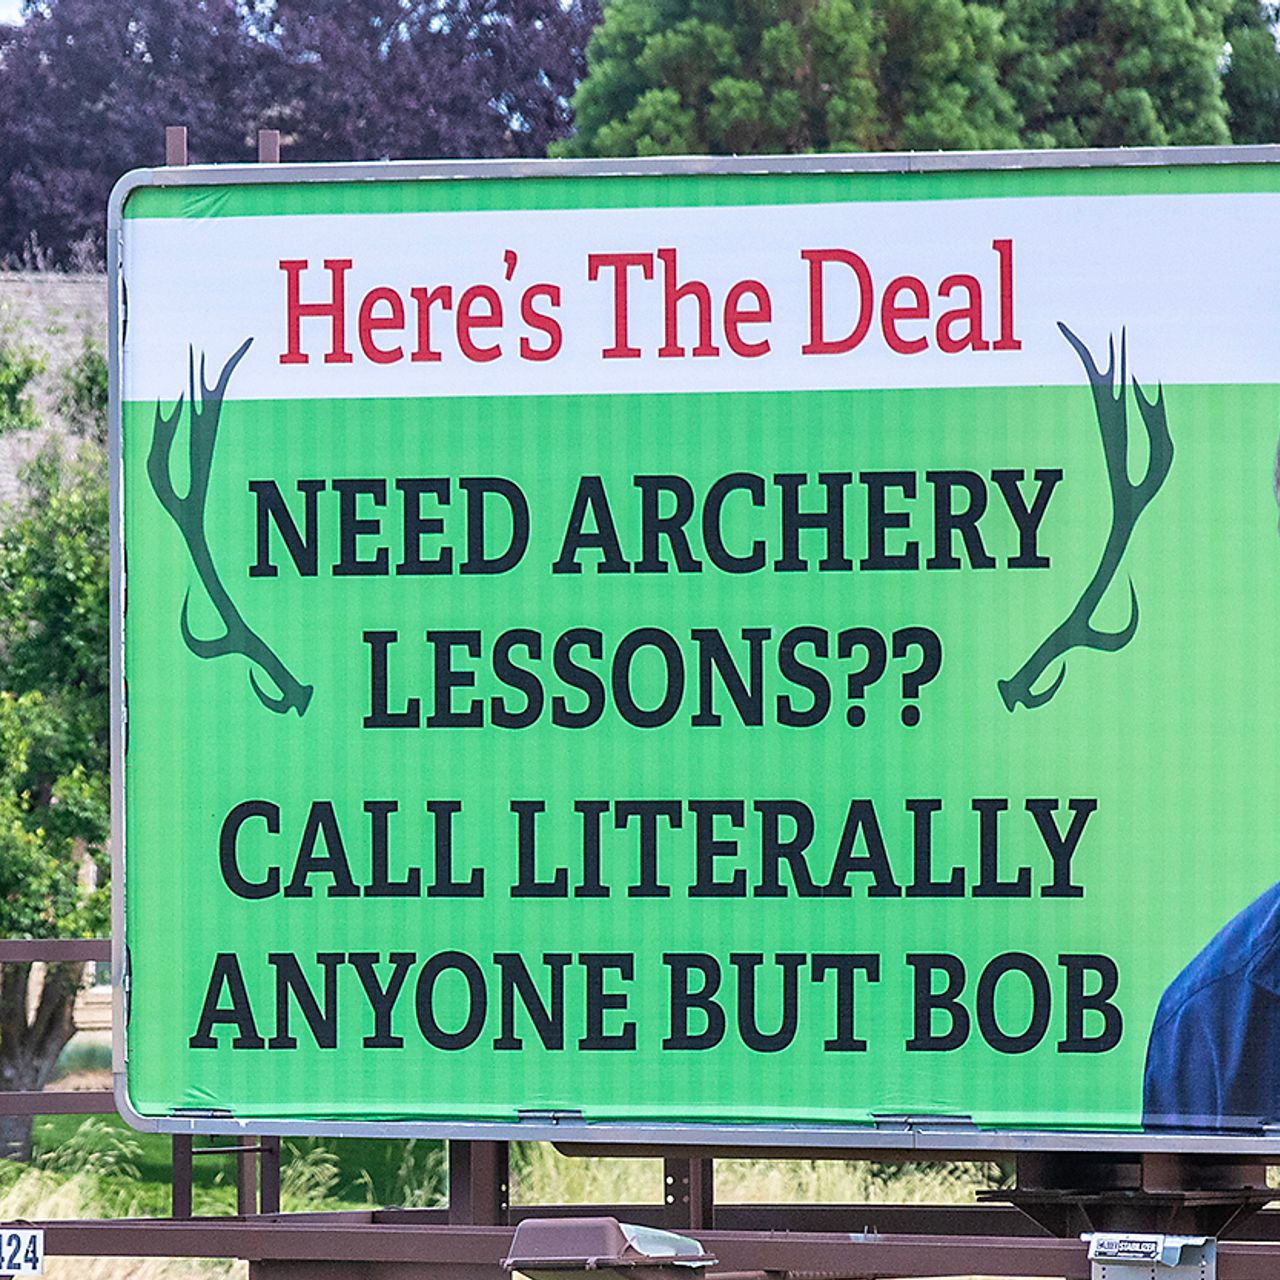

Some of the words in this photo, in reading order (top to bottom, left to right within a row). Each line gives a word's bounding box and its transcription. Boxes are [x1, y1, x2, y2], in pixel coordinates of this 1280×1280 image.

[279, 249, 563, 365] Here’s
[587, 247, 772, 359] The
[800, 239, 1023, 356] Deal
[248, 477, 530, 578] NEED
[552, 468, 1064, 575] ARCHERY
[362, 626, 942, 730] LESSONS??
[219, 800, 485, 900] CALL
[510, 798, 1098, 898] LITERALLY
[188, 950, 637, 1051] ANYONE
[662, 952, 881, 1053] BUT
[905, 951, 1123, 1055] BOB
